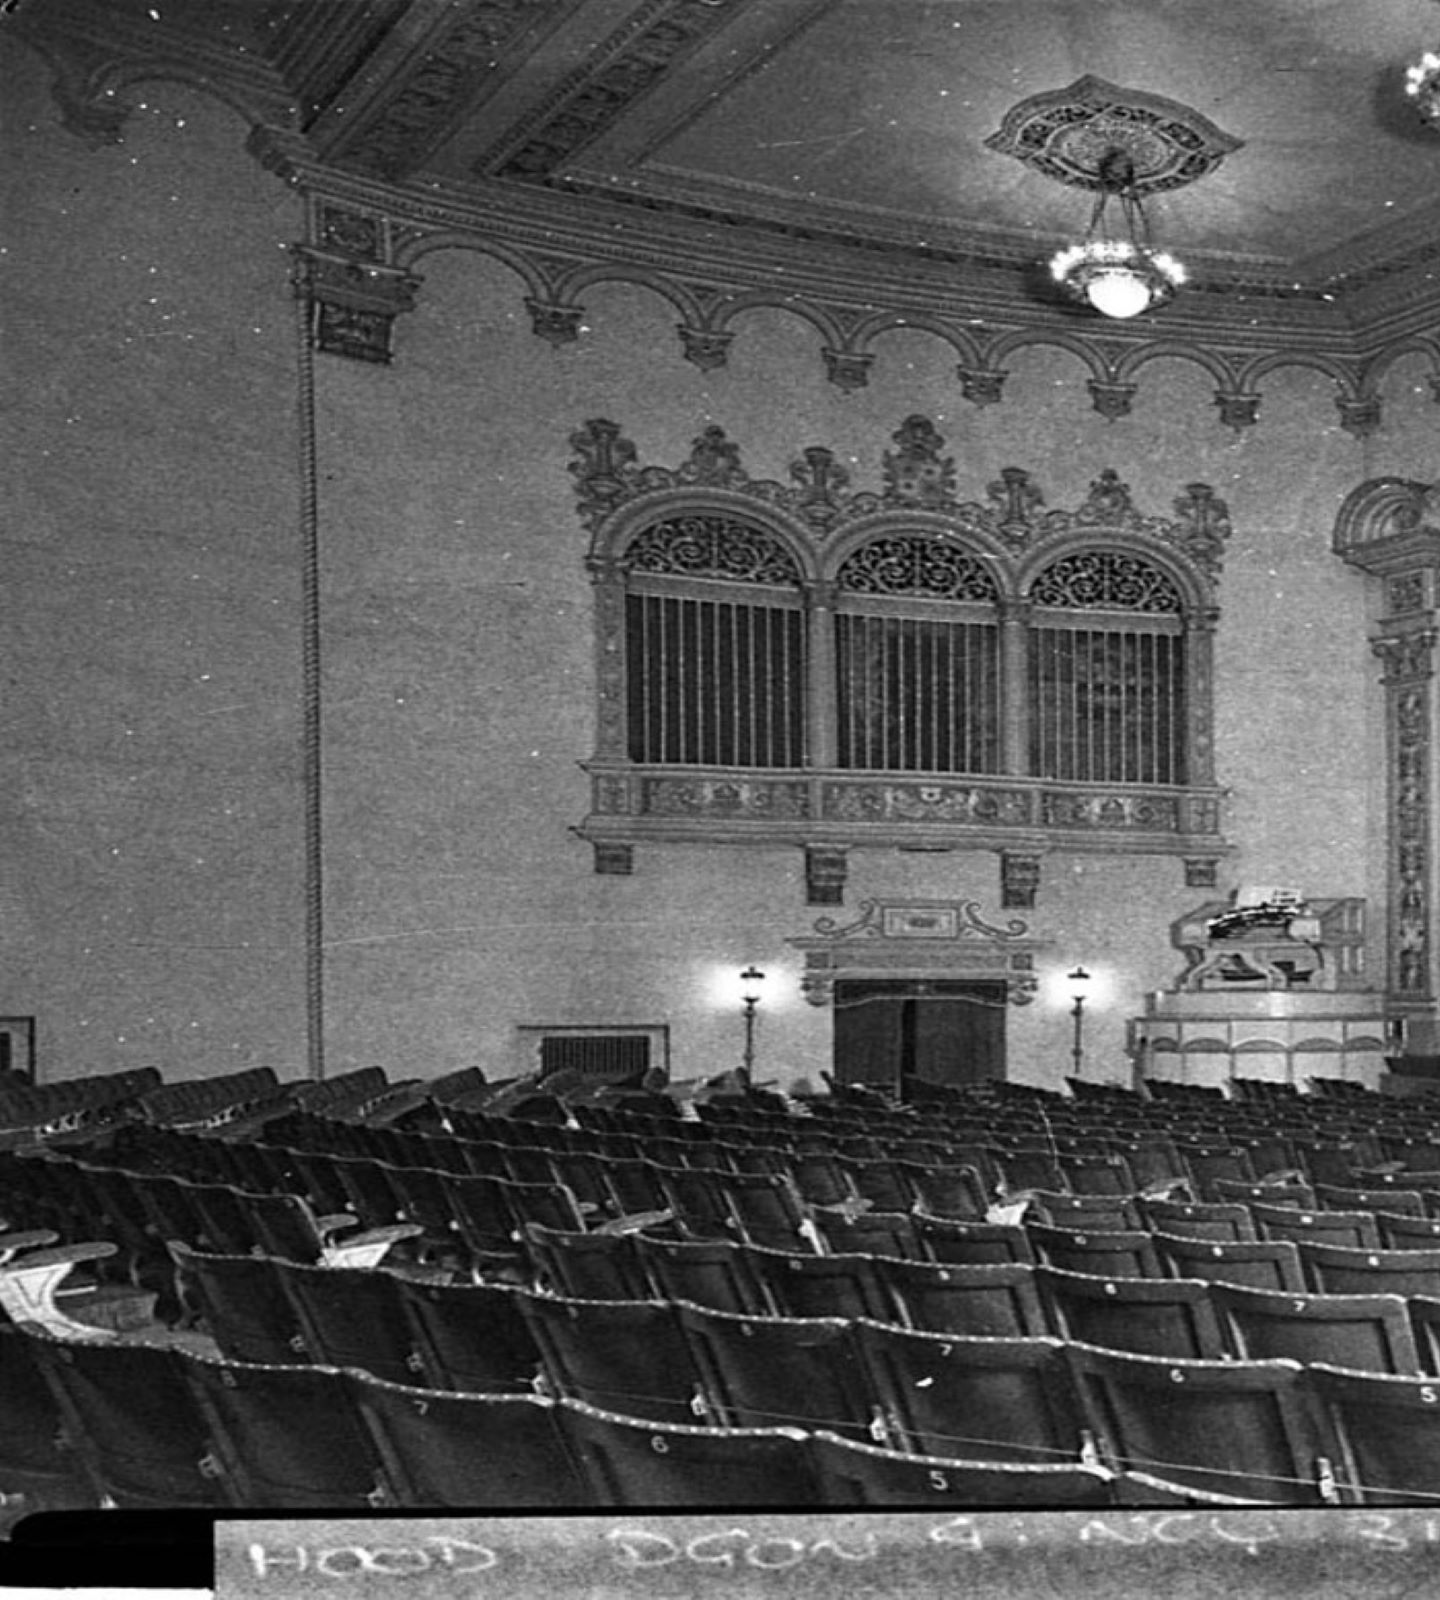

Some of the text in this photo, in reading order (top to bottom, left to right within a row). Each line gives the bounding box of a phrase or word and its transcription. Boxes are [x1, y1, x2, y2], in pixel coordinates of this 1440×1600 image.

[1294, 1300, 1306, 1312] 7
[940, 1343, 953, 1356] 7
[1170, 1368, 1185, 1383] 6
[1420, 1386, 1438, 1403] 5
[413, 1399, 429, 1416] 7
[651, 1435, 669, 1454] 6
[929, 1470, 949, 1491] 5
[248, 1536, 496, 1577] HOOD
